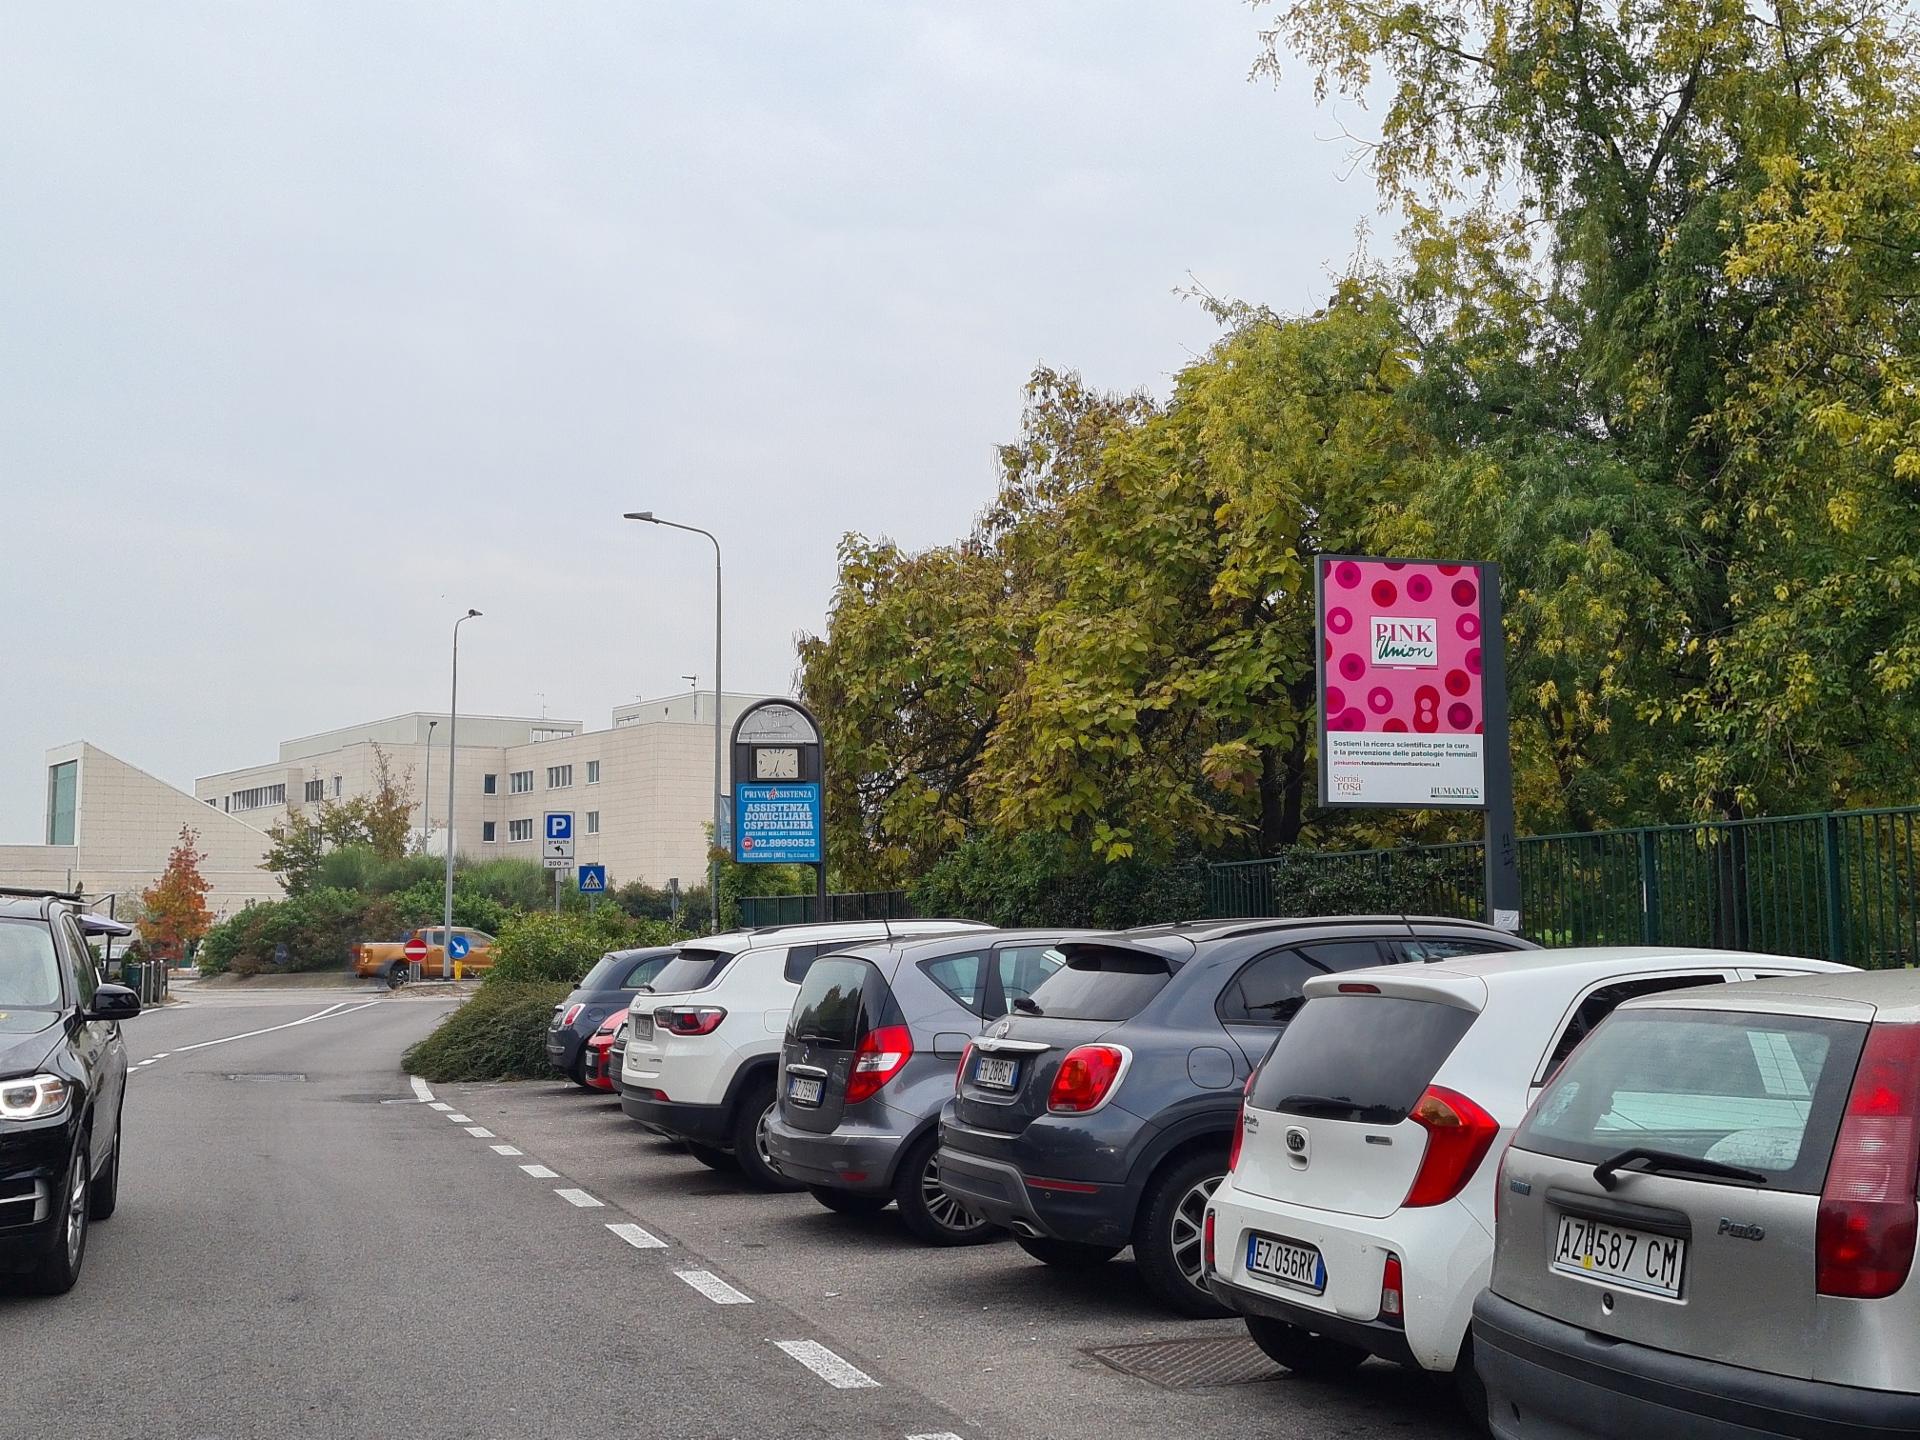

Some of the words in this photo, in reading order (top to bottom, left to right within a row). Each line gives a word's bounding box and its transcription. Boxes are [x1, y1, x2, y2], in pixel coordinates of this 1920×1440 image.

[1376, 623, 1433, 642] PINK
[1375, 635, 1433, 659] Union
[1333, 740, 1362, 748] Sostieni
[1363, 740, 1370, 748] la
[1396, 741, 1432, 749] scientifica
[1347, 749, 1392, 757] prevenzione
[1410, 750, 1445, 758] patologie
[1337, 782, 1361, 791] rosa
[1430, 786, 1479, 794] HUMANITAS
[747, 803, 810, 812] ASSISTENZA
[744, 812, 813, 821] DOMICILIARE
[551, 817, 567, 836] P
[743, 821, 814, 830] OSPEDALIERA
[1717, 1215, 1766, 1241] Punto
[1559, 1221, 1585, 1261] AZ
[1594, 1229, 1638, 1273] 587
[1646, 1239, 1679, 1283] CM
[1254, 1240, 1272, 1270] EZ
[1274, 1246, 1316, 1282] 036RK
